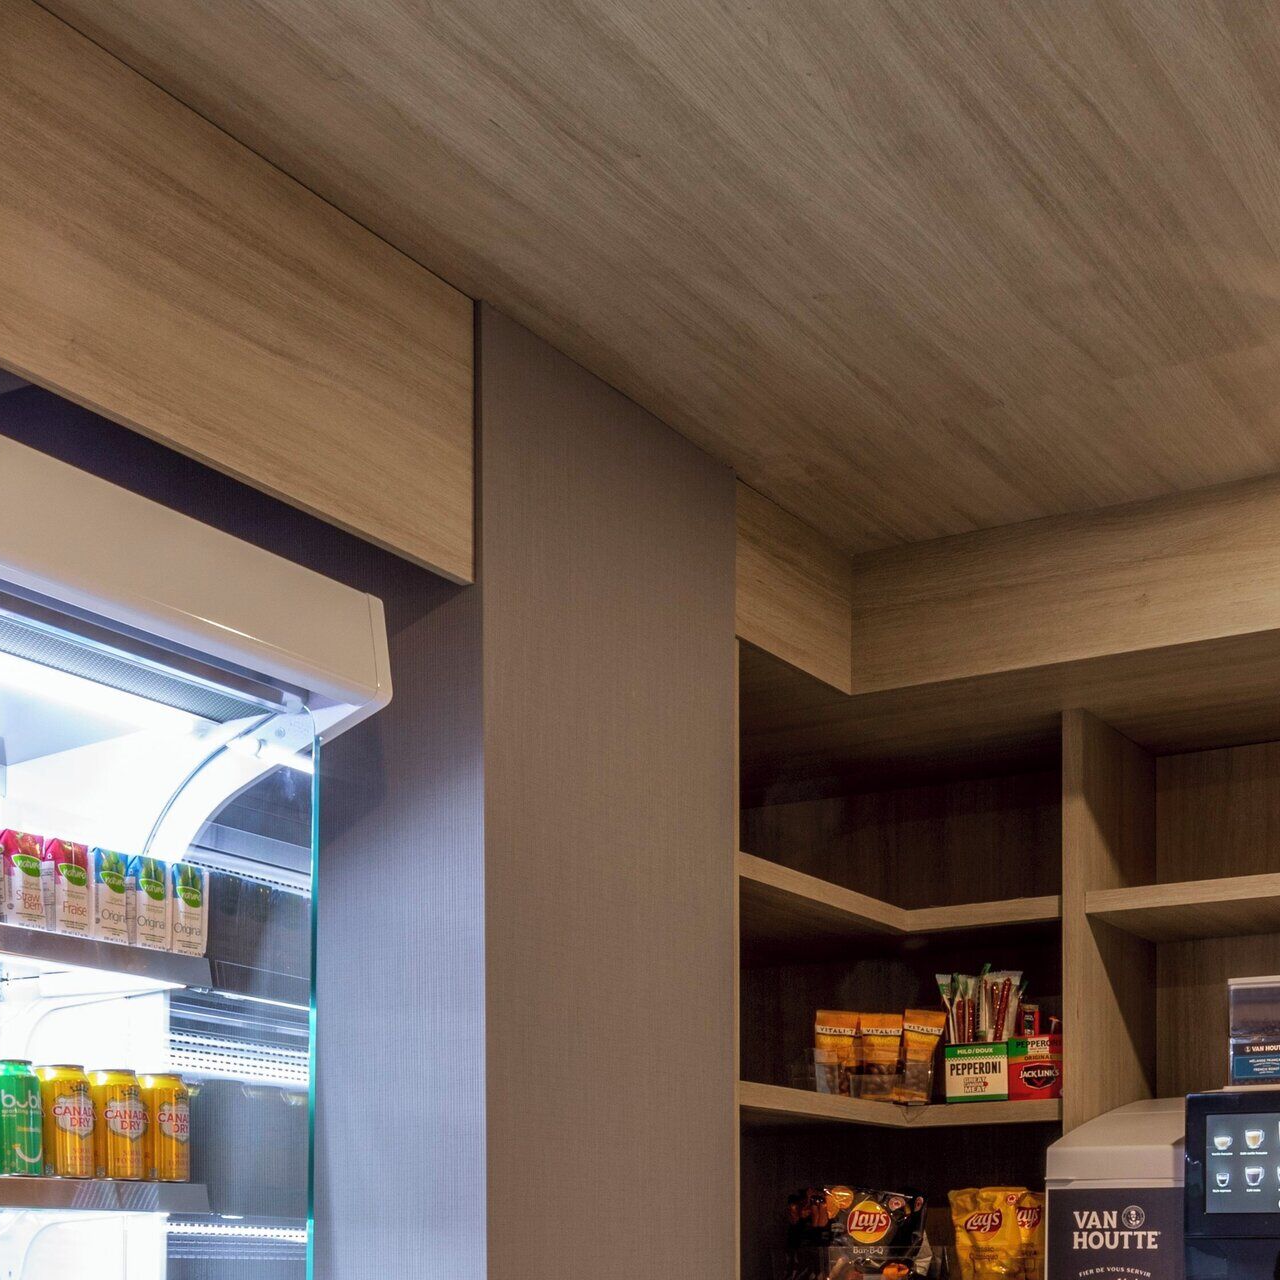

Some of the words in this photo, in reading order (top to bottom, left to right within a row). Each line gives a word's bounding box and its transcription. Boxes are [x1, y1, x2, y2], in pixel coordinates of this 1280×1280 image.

[62, 900, 87, 917] Fraise
[956, 1047, 994, 1055] MILD/DOUX
[950, 1060, 1002, 1075] PEPPERONI
[1019, 1069, 1036, 1079] JACK
[52, 1103, 98, 1121] CANADA
[103, 1107, 149, 1123] CANADA
[70, 1114, 92, 1129] DRY
[121, 1118, 143, 1132] DRY
[851, 1212, 888, 1233] Lay's
[966, 1210, 1001, 1231] Lay's
[1072, 1210, 1119, 1230] VAN
[1072, 1230, 1160, 1250] HOUTTE
[1078, 1268, 1094, 1278] FIER
[1126, 1267, 1152, 1278] SERVIR
